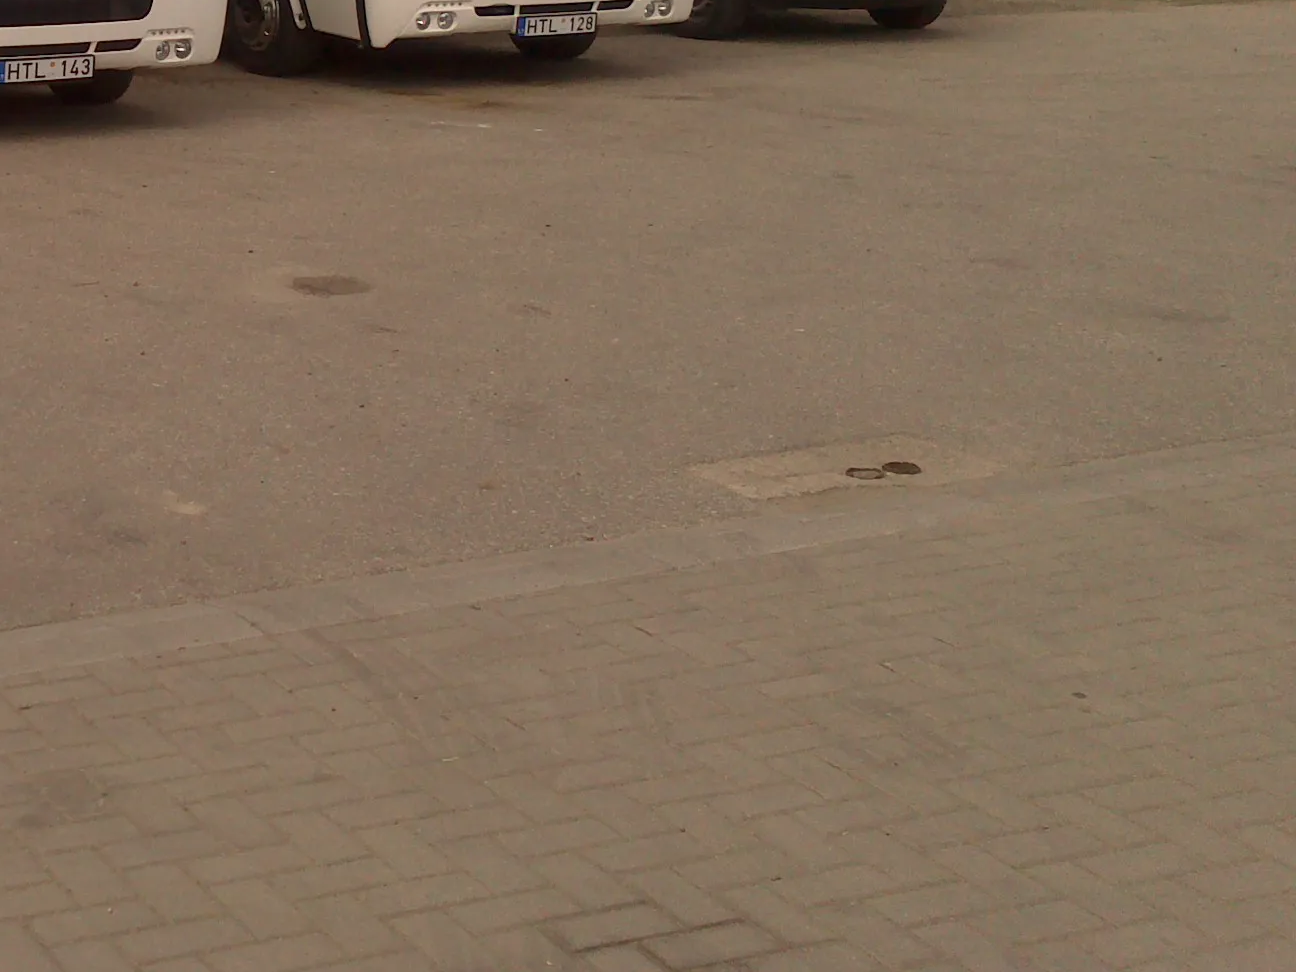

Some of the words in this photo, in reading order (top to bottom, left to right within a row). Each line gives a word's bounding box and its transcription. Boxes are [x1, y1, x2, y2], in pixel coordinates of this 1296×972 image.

[527, 18, 558, 34] HTL
[570, 16, 593, 32] 128
[7, 62, 46, 80] HTL
[61, 58, 90, 77] 143
